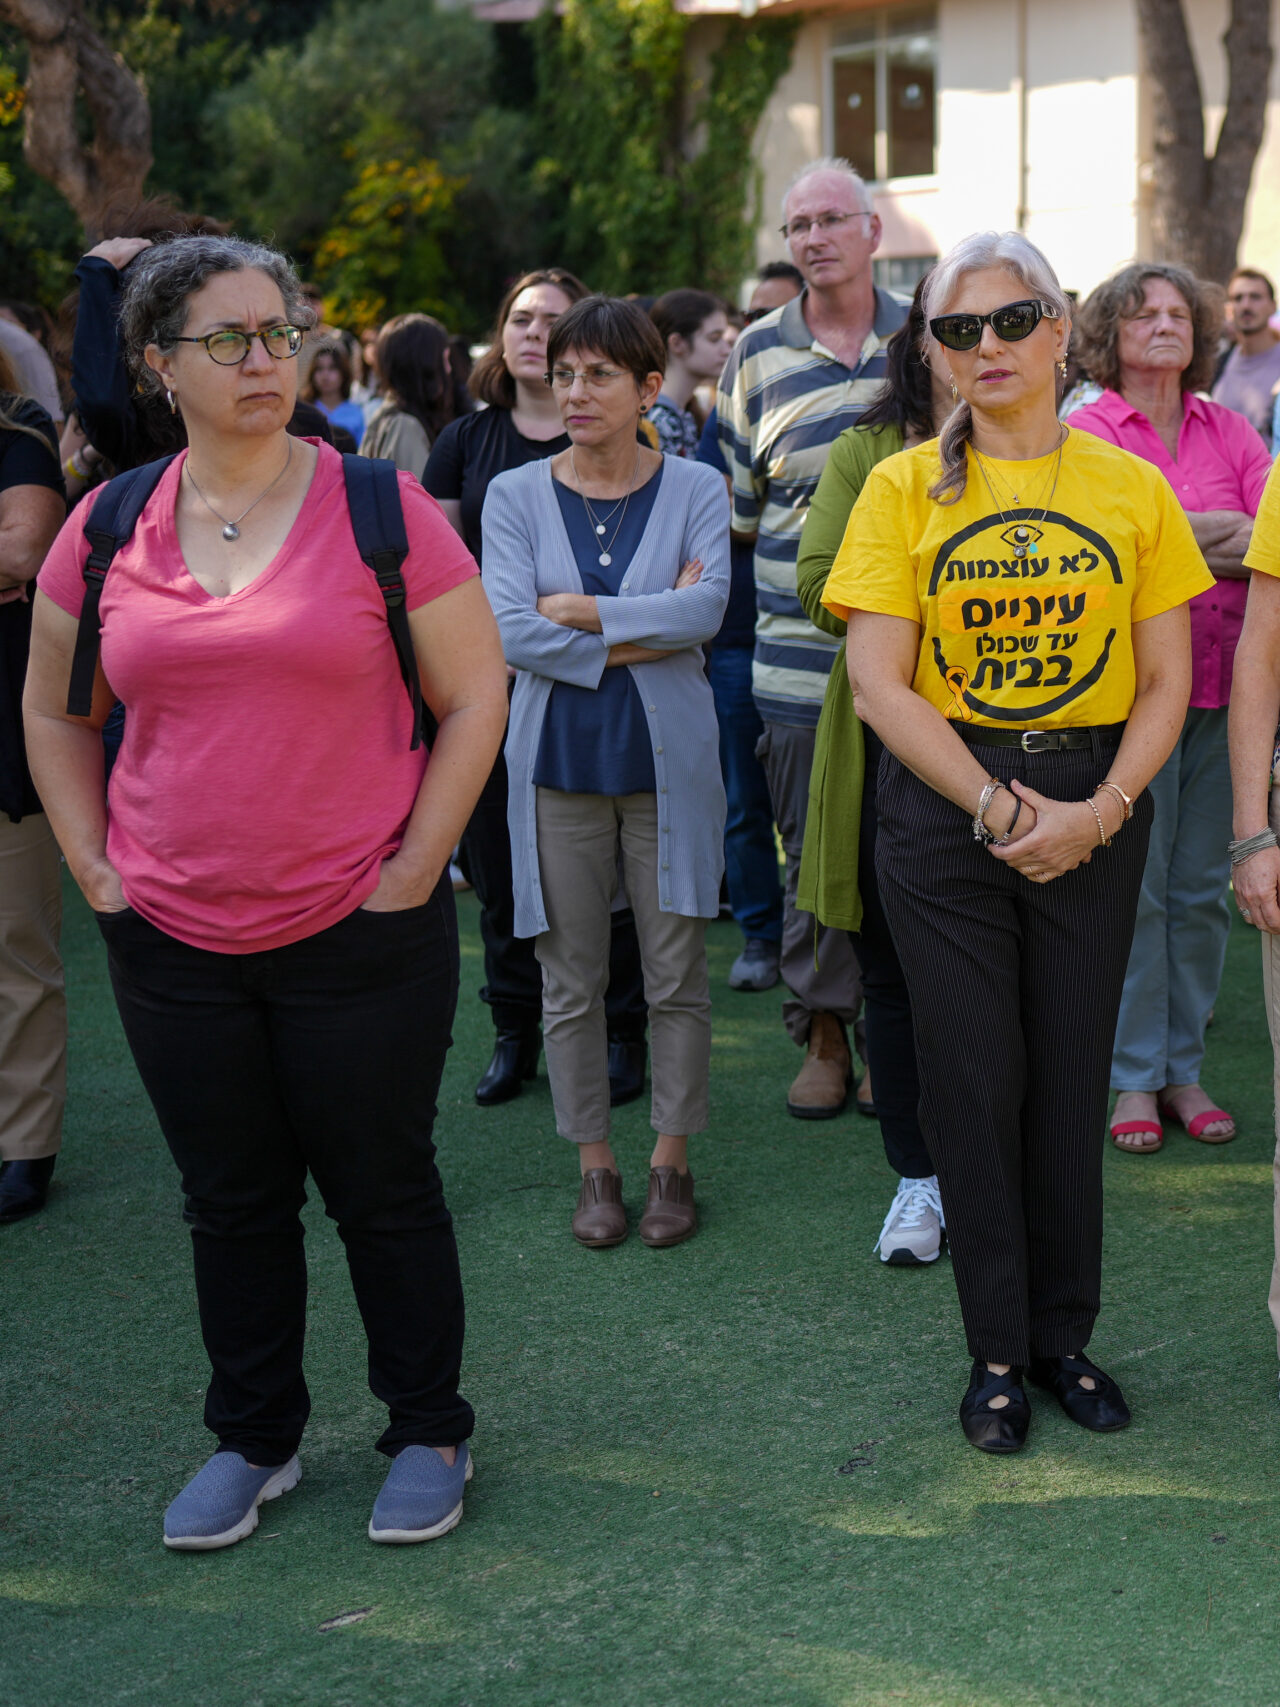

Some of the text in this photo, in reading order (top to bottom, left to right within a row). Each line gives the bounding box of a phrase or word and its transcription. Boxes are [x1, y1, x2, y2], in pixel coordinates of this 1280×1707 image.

[946, 548, 1099, 581] לא עוצמות
[961, 592, 1087, 630] עיניים
[976, 632, 1078, 656] עד שכולן
[969, 655, 1073, 690] בבית
